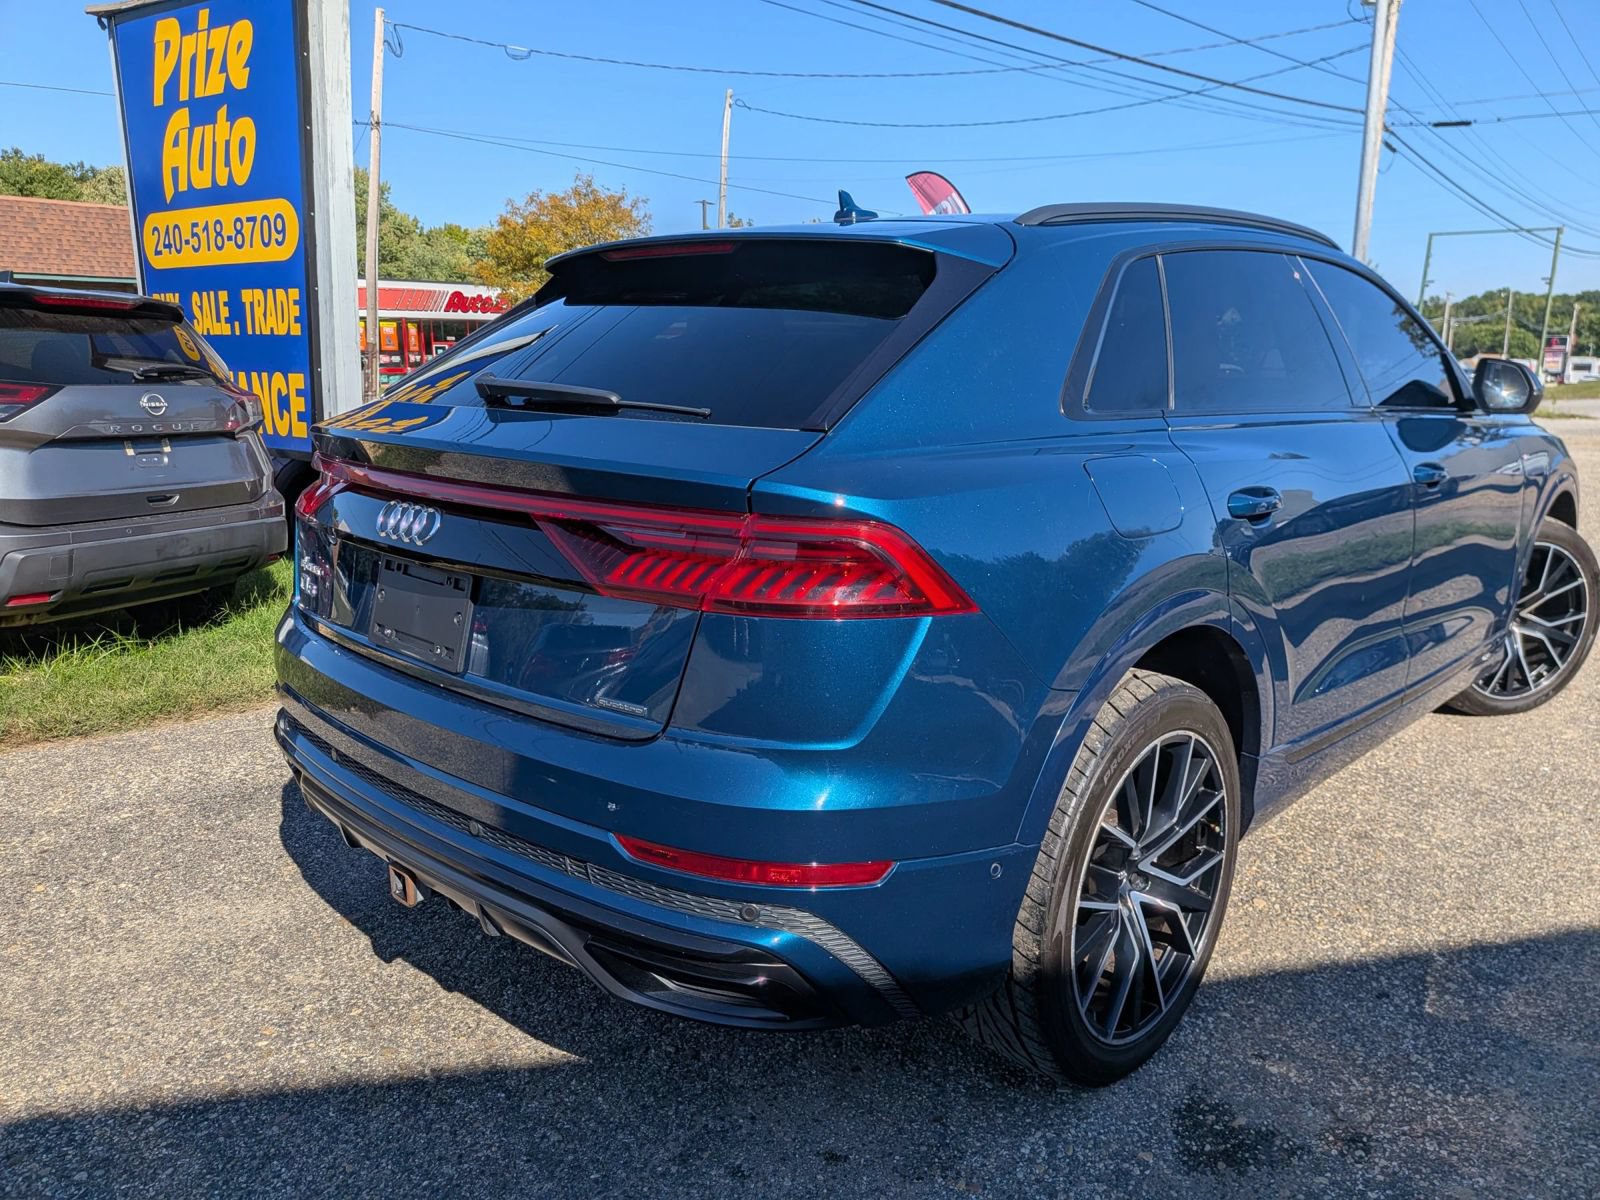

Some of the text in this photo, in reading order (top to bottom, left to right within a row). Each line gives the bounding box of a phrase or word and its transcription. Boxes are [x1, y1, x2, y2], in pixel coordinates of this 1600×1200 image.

[153, 8, 253, 107] Prize
[162, 104, 256, 204] Auto
[152, 213, 287, 257] 240-518-8709
[241, 288, 301, 336] TRADE
[140, 400, 168, 408] NISSAN
[110, 423, 200, 434] ROGUE
